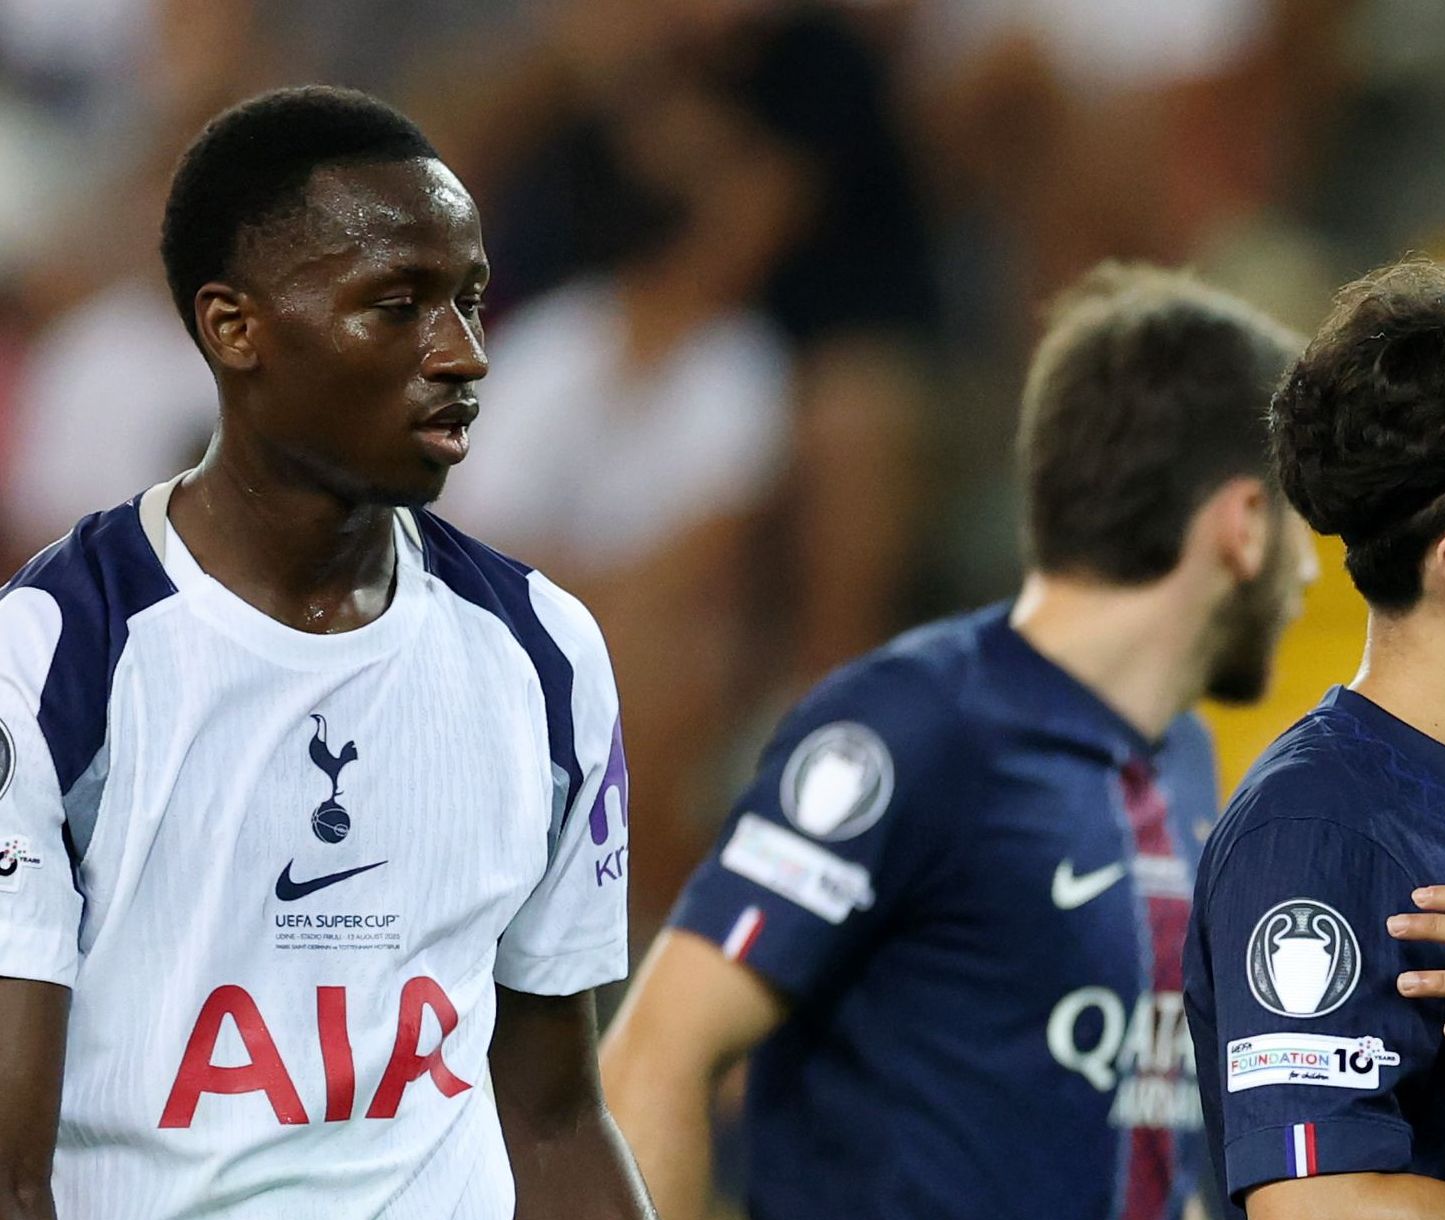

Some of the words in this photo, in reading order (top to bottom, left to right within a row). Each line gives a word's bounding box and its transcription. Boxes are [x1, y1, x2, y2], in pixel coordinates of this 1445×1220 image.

[275, 914, 313, 928] UEFA
[316, 914, 363, 928] SUPER
[157, 975, 473, 1129] AIA
[1231, 1052, 1330, 1073] FOUNDATION
[1333, 1048, 1374, 1074] 10
[1301, 1071, 1330, 1081] children
